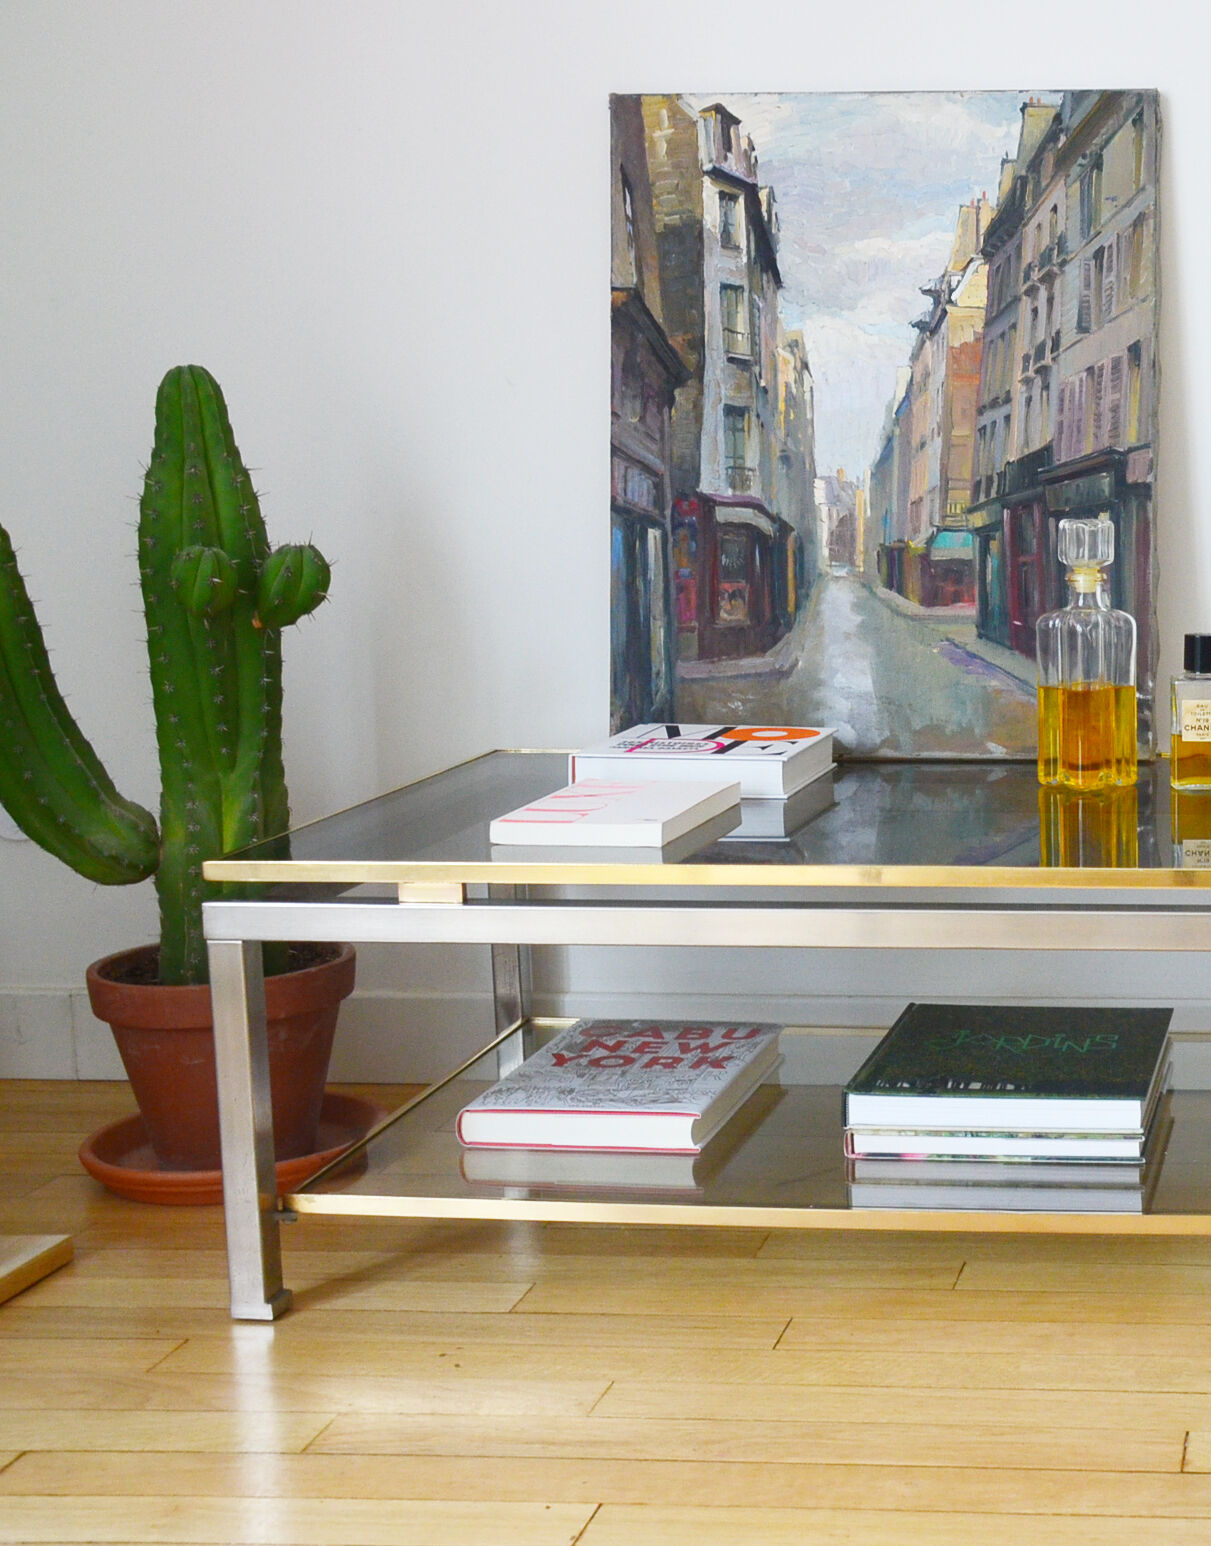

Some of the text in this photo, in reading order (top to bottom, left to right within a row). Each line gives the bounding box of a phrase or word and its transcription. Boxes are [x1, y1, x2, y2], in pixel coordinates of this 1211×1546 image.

[579, 1025, 762, 1041] CABU
[579, 1038, 734, 1055] NEW
[551, 1052, 736, 1070] YORK
